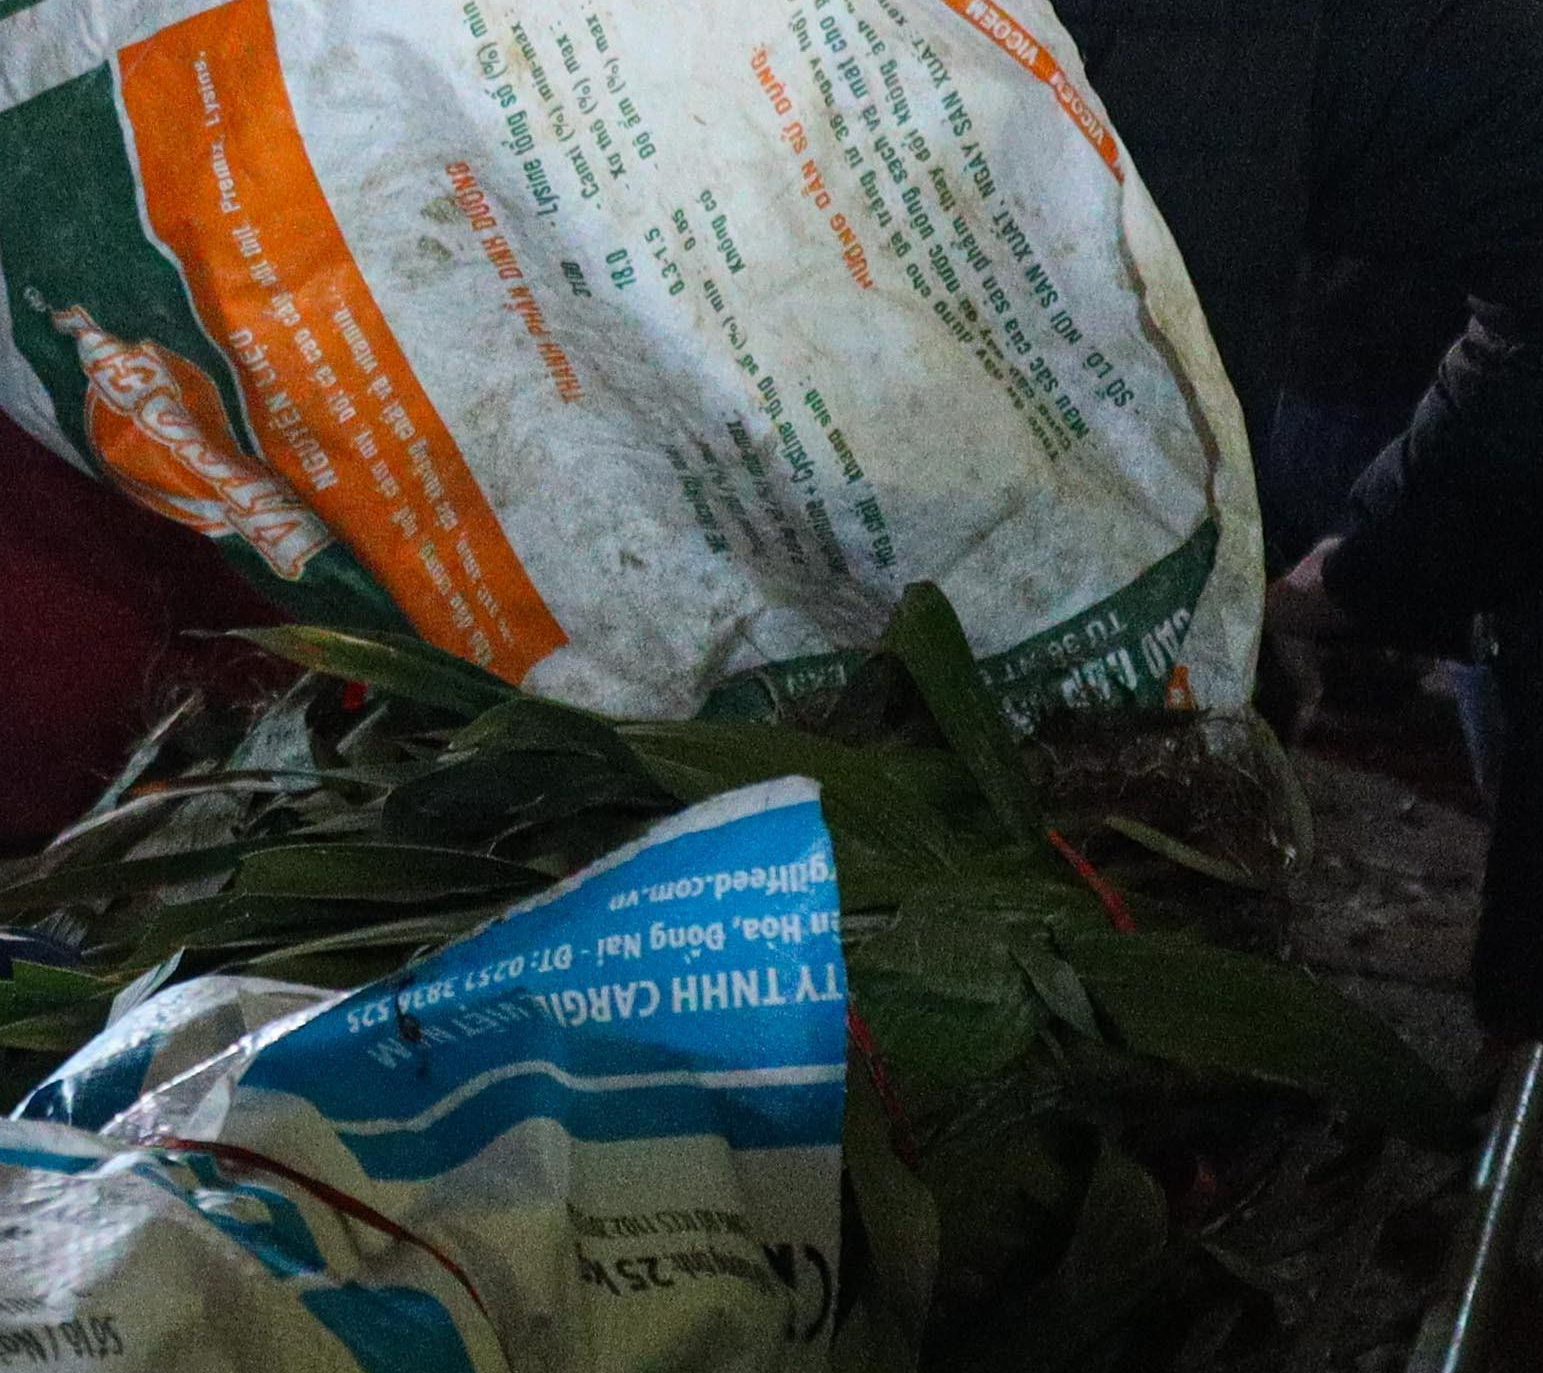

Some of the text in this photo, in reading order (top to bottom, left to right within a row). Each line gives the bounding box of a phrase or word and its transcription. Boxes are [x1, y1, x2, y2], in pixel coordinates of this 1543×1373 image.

[456, 0, 489, 40] min
[580, 12, 613, 54] max
[813, 13, 850, 55] cho
[472, 39, 510, 82] (%)
[505, 20, 558, 102] min-max
[550, 32, 583, 75] max
[596, 55, 631, 94] (%)
[483, 77, 520, 113] số
[569, 75, 603, 115] (%)
[800, 55, 842, 110] ngày
[875, 57, 918, 125] không
[496, 109, 538, 160] tổng
[544, 103, 577, 143] (%)
[826, 113, 850, 142] 36
[854, 104, 881, 134] và
[560, 143, 603, 200] Canxi
[871, 132, 909, 184] sạch
[953, 139, 1002, 201] NGÀY
[430, 157, 498, 241] DƯỠNG
[519, 156, 559, 220] Lysine
[692, 187, 719, 215] có
[921, 163, 961, 213] thay
[481, 232, 523, 286] DINH
[704, 213, 750, 275] Không
[902, 260, 933, 301] cho
[497, 282, 551, 347] PHẦN
[290, 326, 323, 365] cao
[228, 323, 340, 494] NGUYÊN LIỆU
[595, 929, 641, 966] Nai
[648, 918, 725, 965] Đồng
[670, 964, 791, 1014] TNHH
[792, 960, 841, 1003] TY
[614, 1256, 674, 1292] 25
